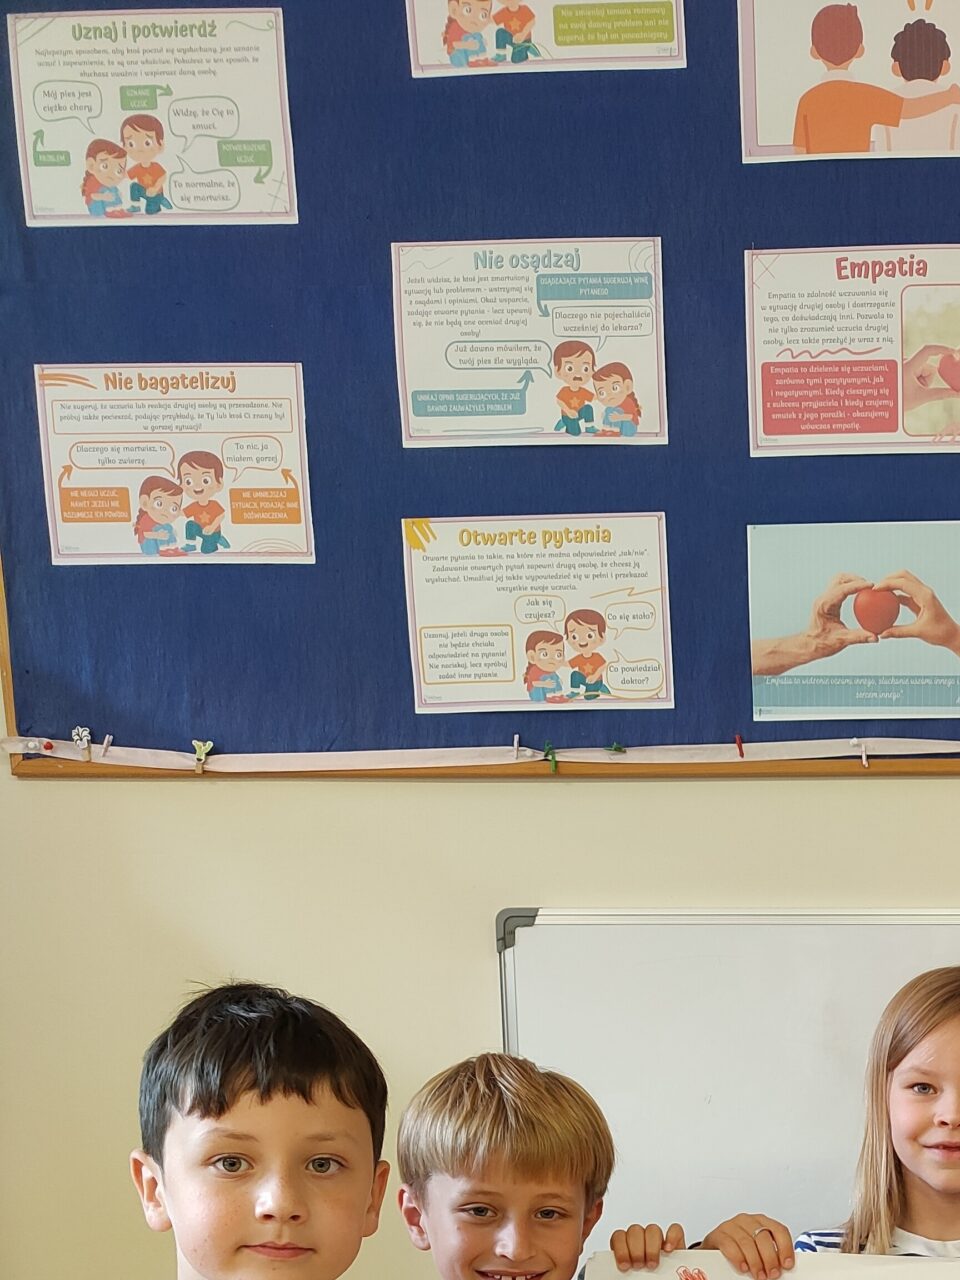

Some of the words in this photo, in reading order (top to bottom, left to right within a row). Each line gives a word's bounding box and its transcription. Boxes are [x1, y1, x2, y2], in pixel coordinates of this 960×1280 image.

[72, 22, 118, 42] Uznaj
[122, 20, 127, 38] i
[132, 20, 216, 42] potwierdź
[43, 90, 58, 100] Mój
[60, 90, 76, 100] pies
[77, 90, 92, 100] jest
[474, 250, 504, 270] Nie
[510, 248, 580, 272] osądzaj
[836, 254, 928, 284] Empatia
[768, 292, 796, 300] Empatia
[878, 289, 888, 298] się
[104, 372, 133, 390] Nie
[138, 370, 236, 394] bagatelizuj
[459, 528, 537, 547] Otwarte
[542, 525, 611, 549] pytania
[542, 599, 552, 608] się
[524, 611, 556, 620] czujesz?
[620, 613, 630, 622] się
[632, 612, 654, 620] stało?
[621, 664, 660, 674] powiedział
[620, 676, 649, 684] doktor?
